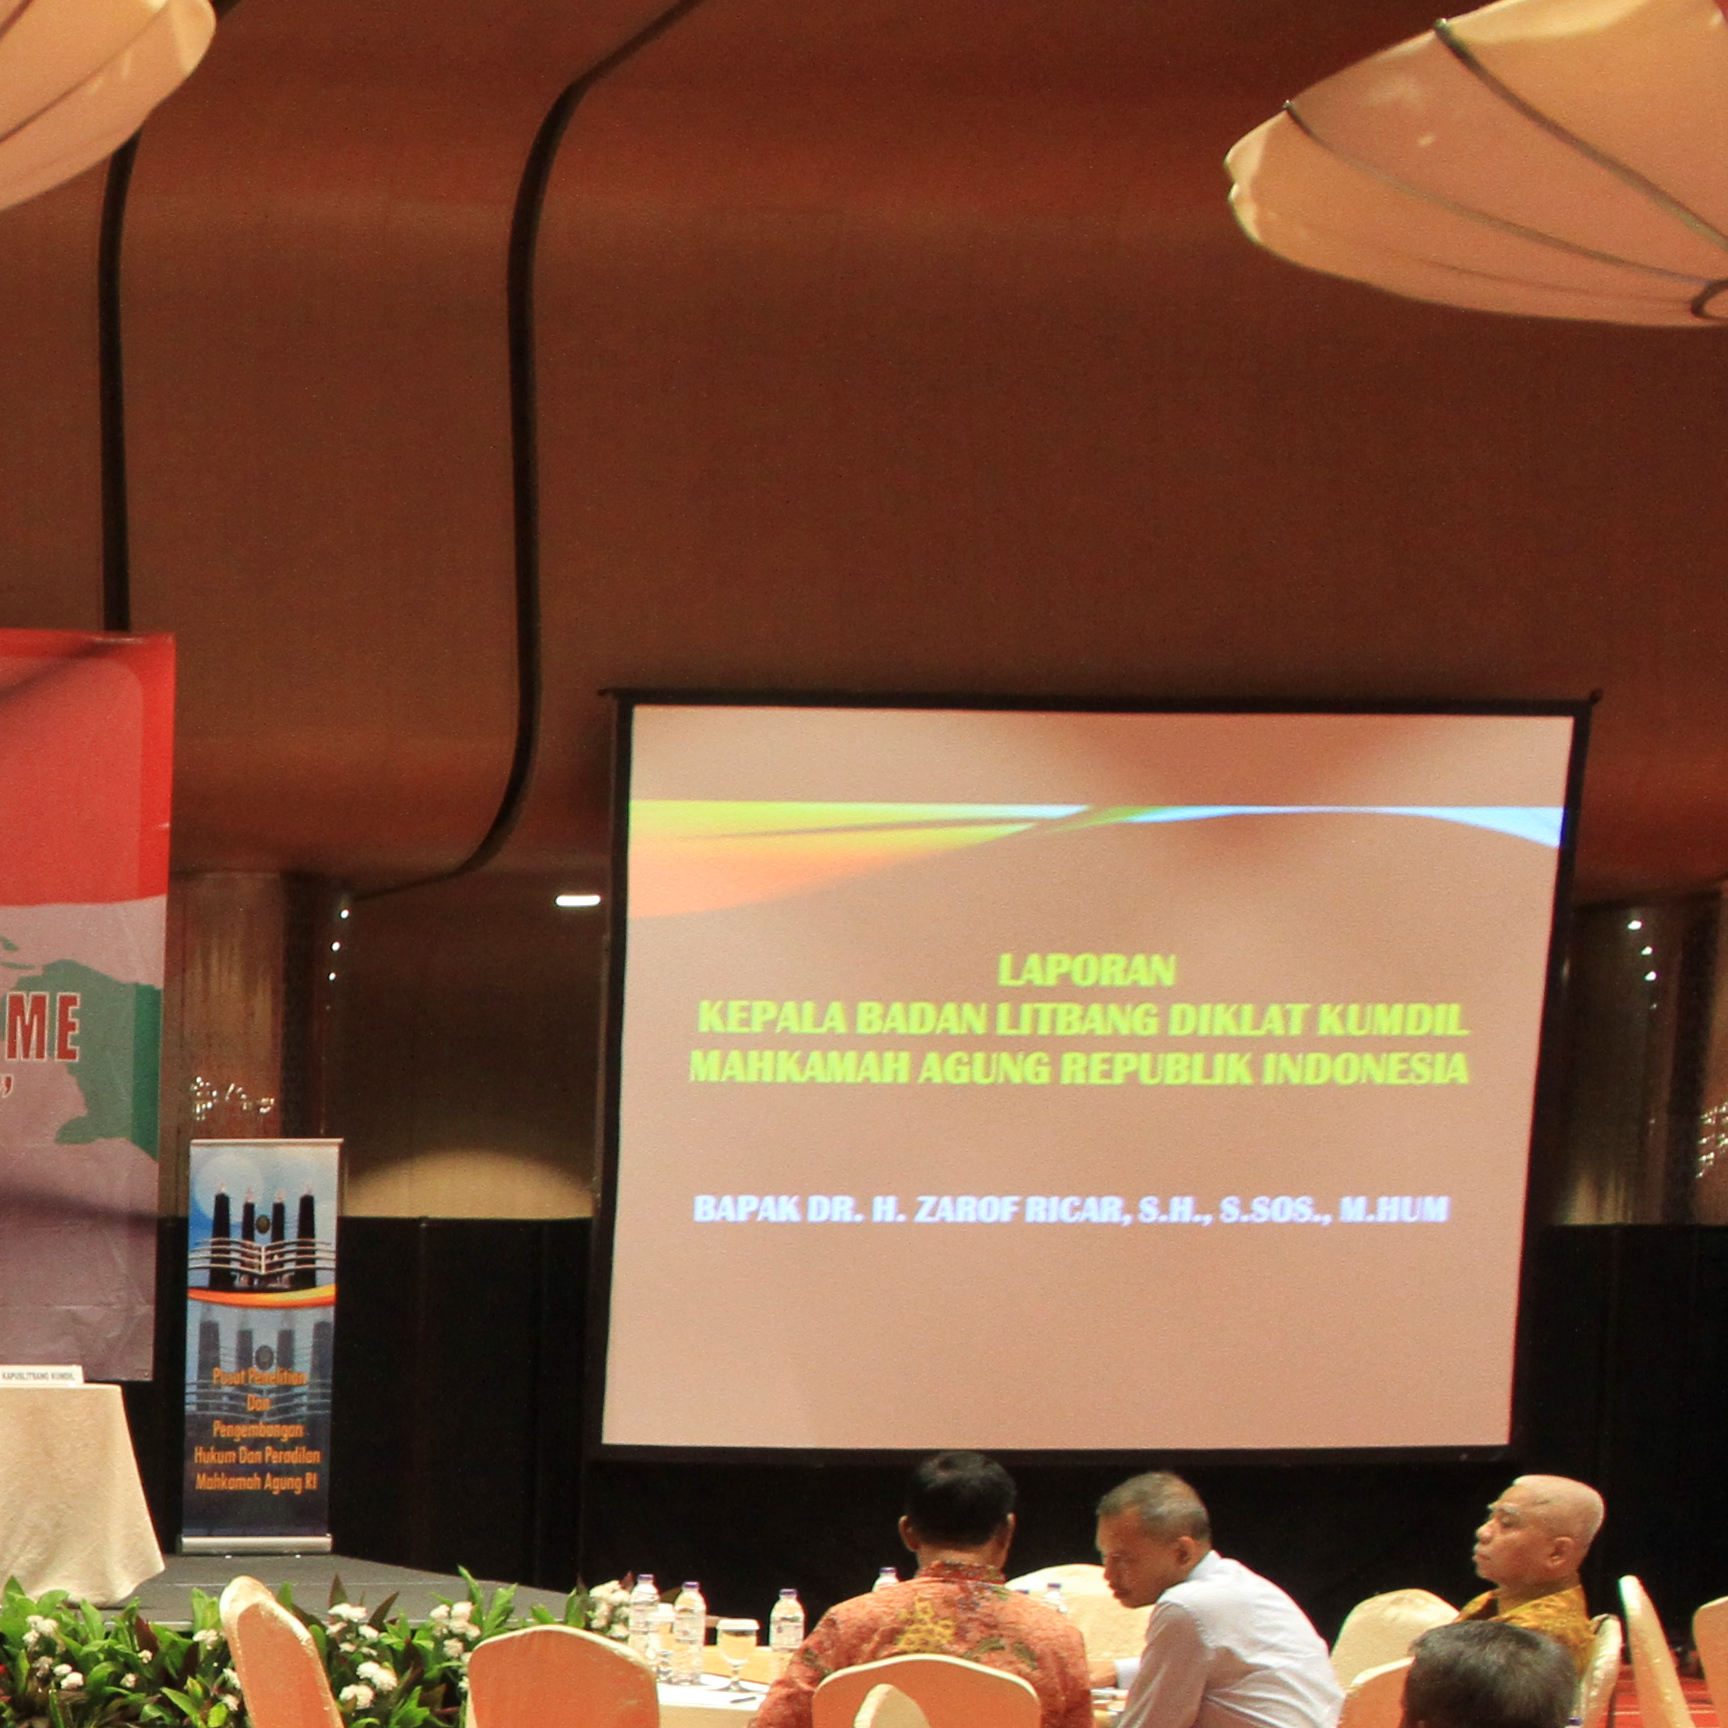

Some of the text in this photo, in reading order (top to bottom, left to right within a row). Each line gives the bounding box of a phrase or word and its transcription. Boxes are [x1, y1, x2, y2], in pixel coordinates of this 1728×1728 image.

[998, 952, 1178, 987] LAPORAN
[697, 1000, 1471, 1038] KEPALA BADAN LITBANG DIKLAT KUMDIL
[689, 1049, 1471, 1087] MAHKAMAH AGUNG REPUBLIK INDONESIA
[693, 1195, 1451, 1228] BAPAK DR. H. ZAROF RICAR, S.H., S.SOS., M.HUM
[212, 1366, 308, 1386] Pusat Penelitian
[247, 1393, 272, 1411] Dan
[212, 1419, 305, 1442] Pengembangan
[194, 1446, 321, 1464] Hukum Dan Peradilan
[196, 1472, 319, 1495] Mahkamah Agung RI
